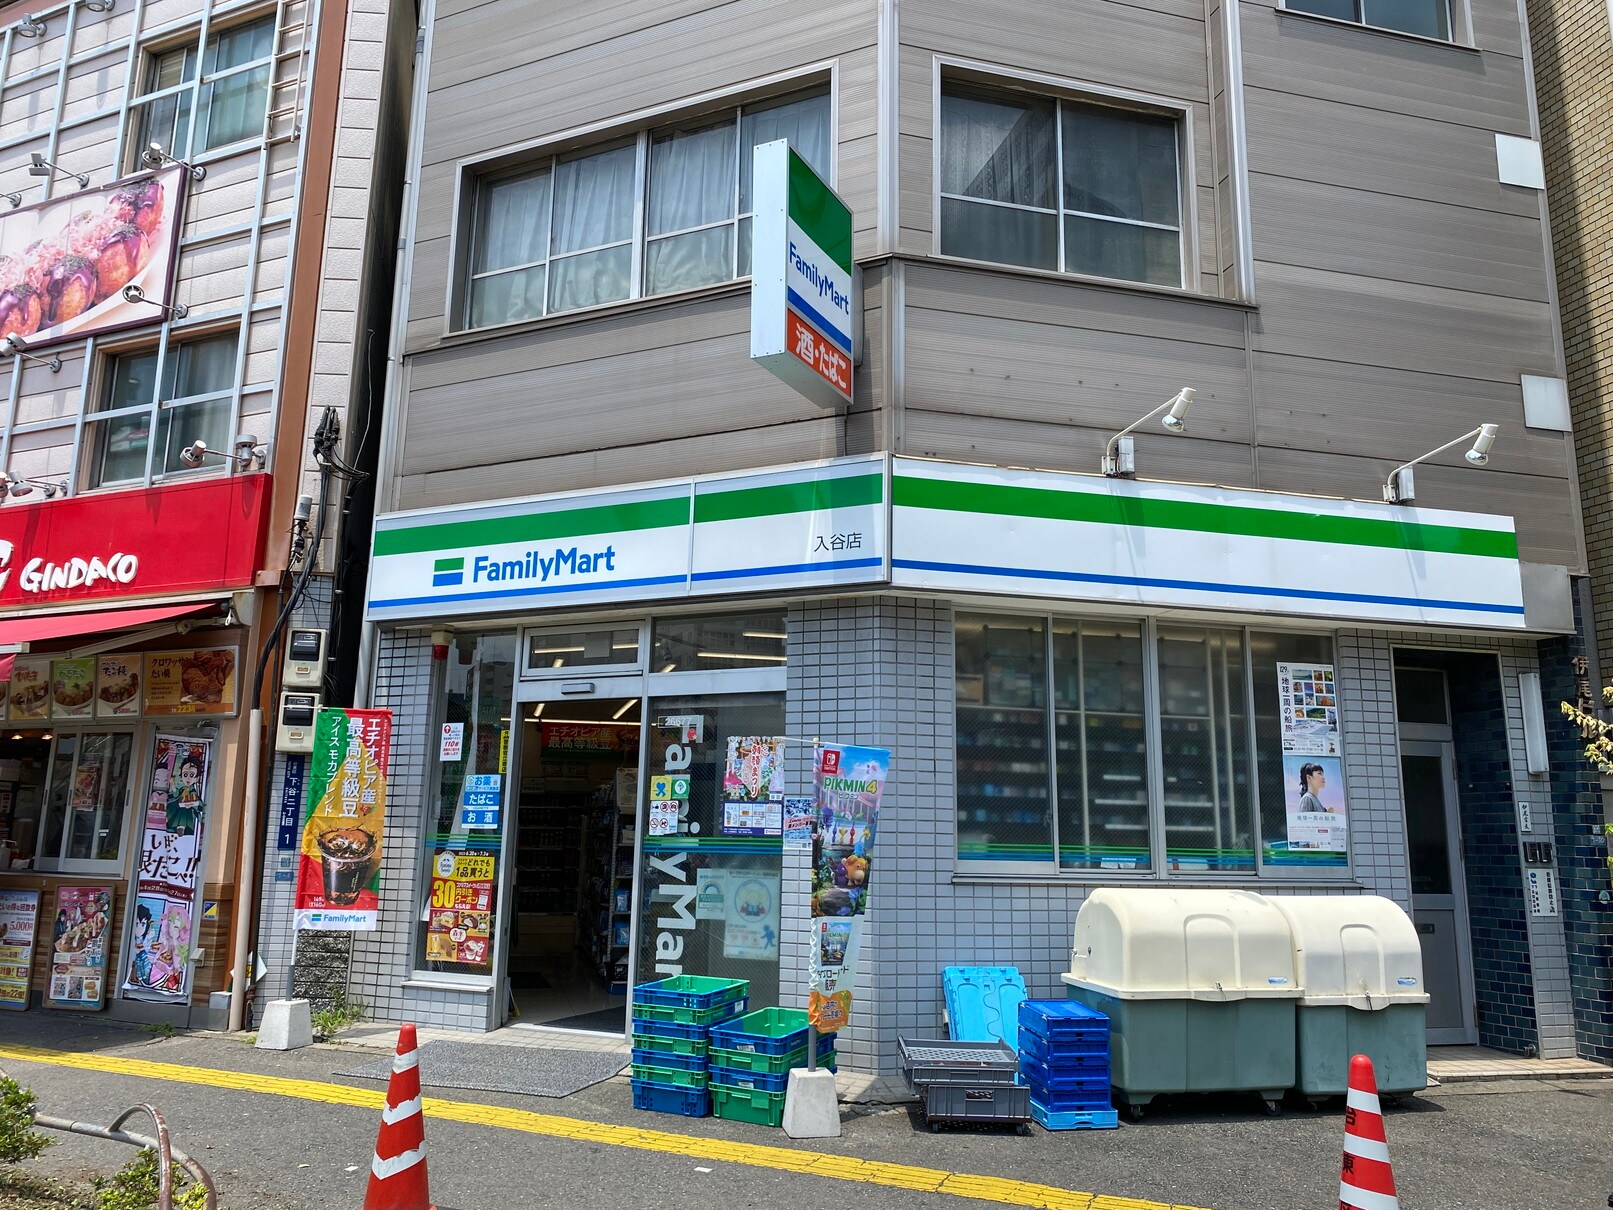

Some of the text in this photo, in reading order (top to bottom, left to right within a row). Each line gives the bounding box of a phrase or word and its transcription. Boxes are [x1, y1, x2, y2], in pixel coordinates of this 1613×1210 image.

[789, 241, 849, 315] FamilyMart
[796, 322, 847, 389] 酒・たばこ
[814, 532, 862, 552] 入谷店
[19, 552, 138, 593] GINDACO
[473, 545, 615, 582] FamilyMart
[549, 726, 612, 739] エチオピア産
[548, 736, 612, 750] 最高等級豆
[339, 717, 365, 818] 最高等級豆
[361, 718, 382, 804] エチオピア産
[824, 777, 878, 795] PIKMIN 4
[285, 777, 298, 826] 下谷二丁目
[469, 793, 494, 805] たばこ
[284, 833, 291, 844] 1
[468, 858, 490, 867] どれでも
[456, 867, 489, 878] 1品買うと
[432, 880, 456, 909] 30
[455, 896, 478, 904] クーポン
[323, 914, 366, 923] FamilyMart
